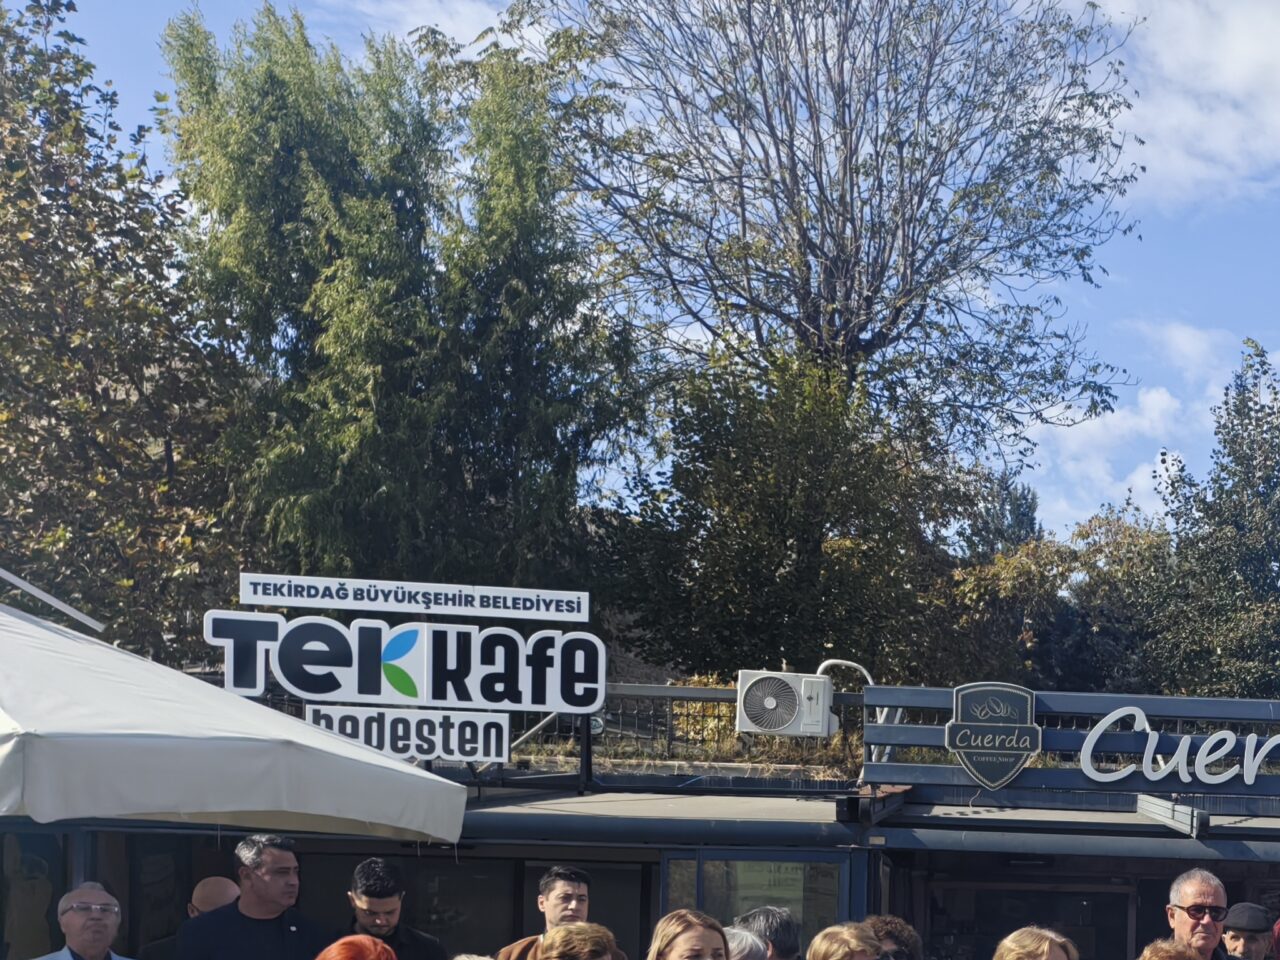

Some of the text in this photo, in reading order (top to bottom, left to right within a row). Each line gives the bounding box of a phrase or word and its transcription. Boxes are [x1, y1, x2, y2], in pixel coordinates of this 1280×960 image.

[249, 580, 582, 614] TEKİRDAĞ BÜYÜKŞEHİR BELEDİYESİ
[956, 729, 1030, 748] Cuerda
